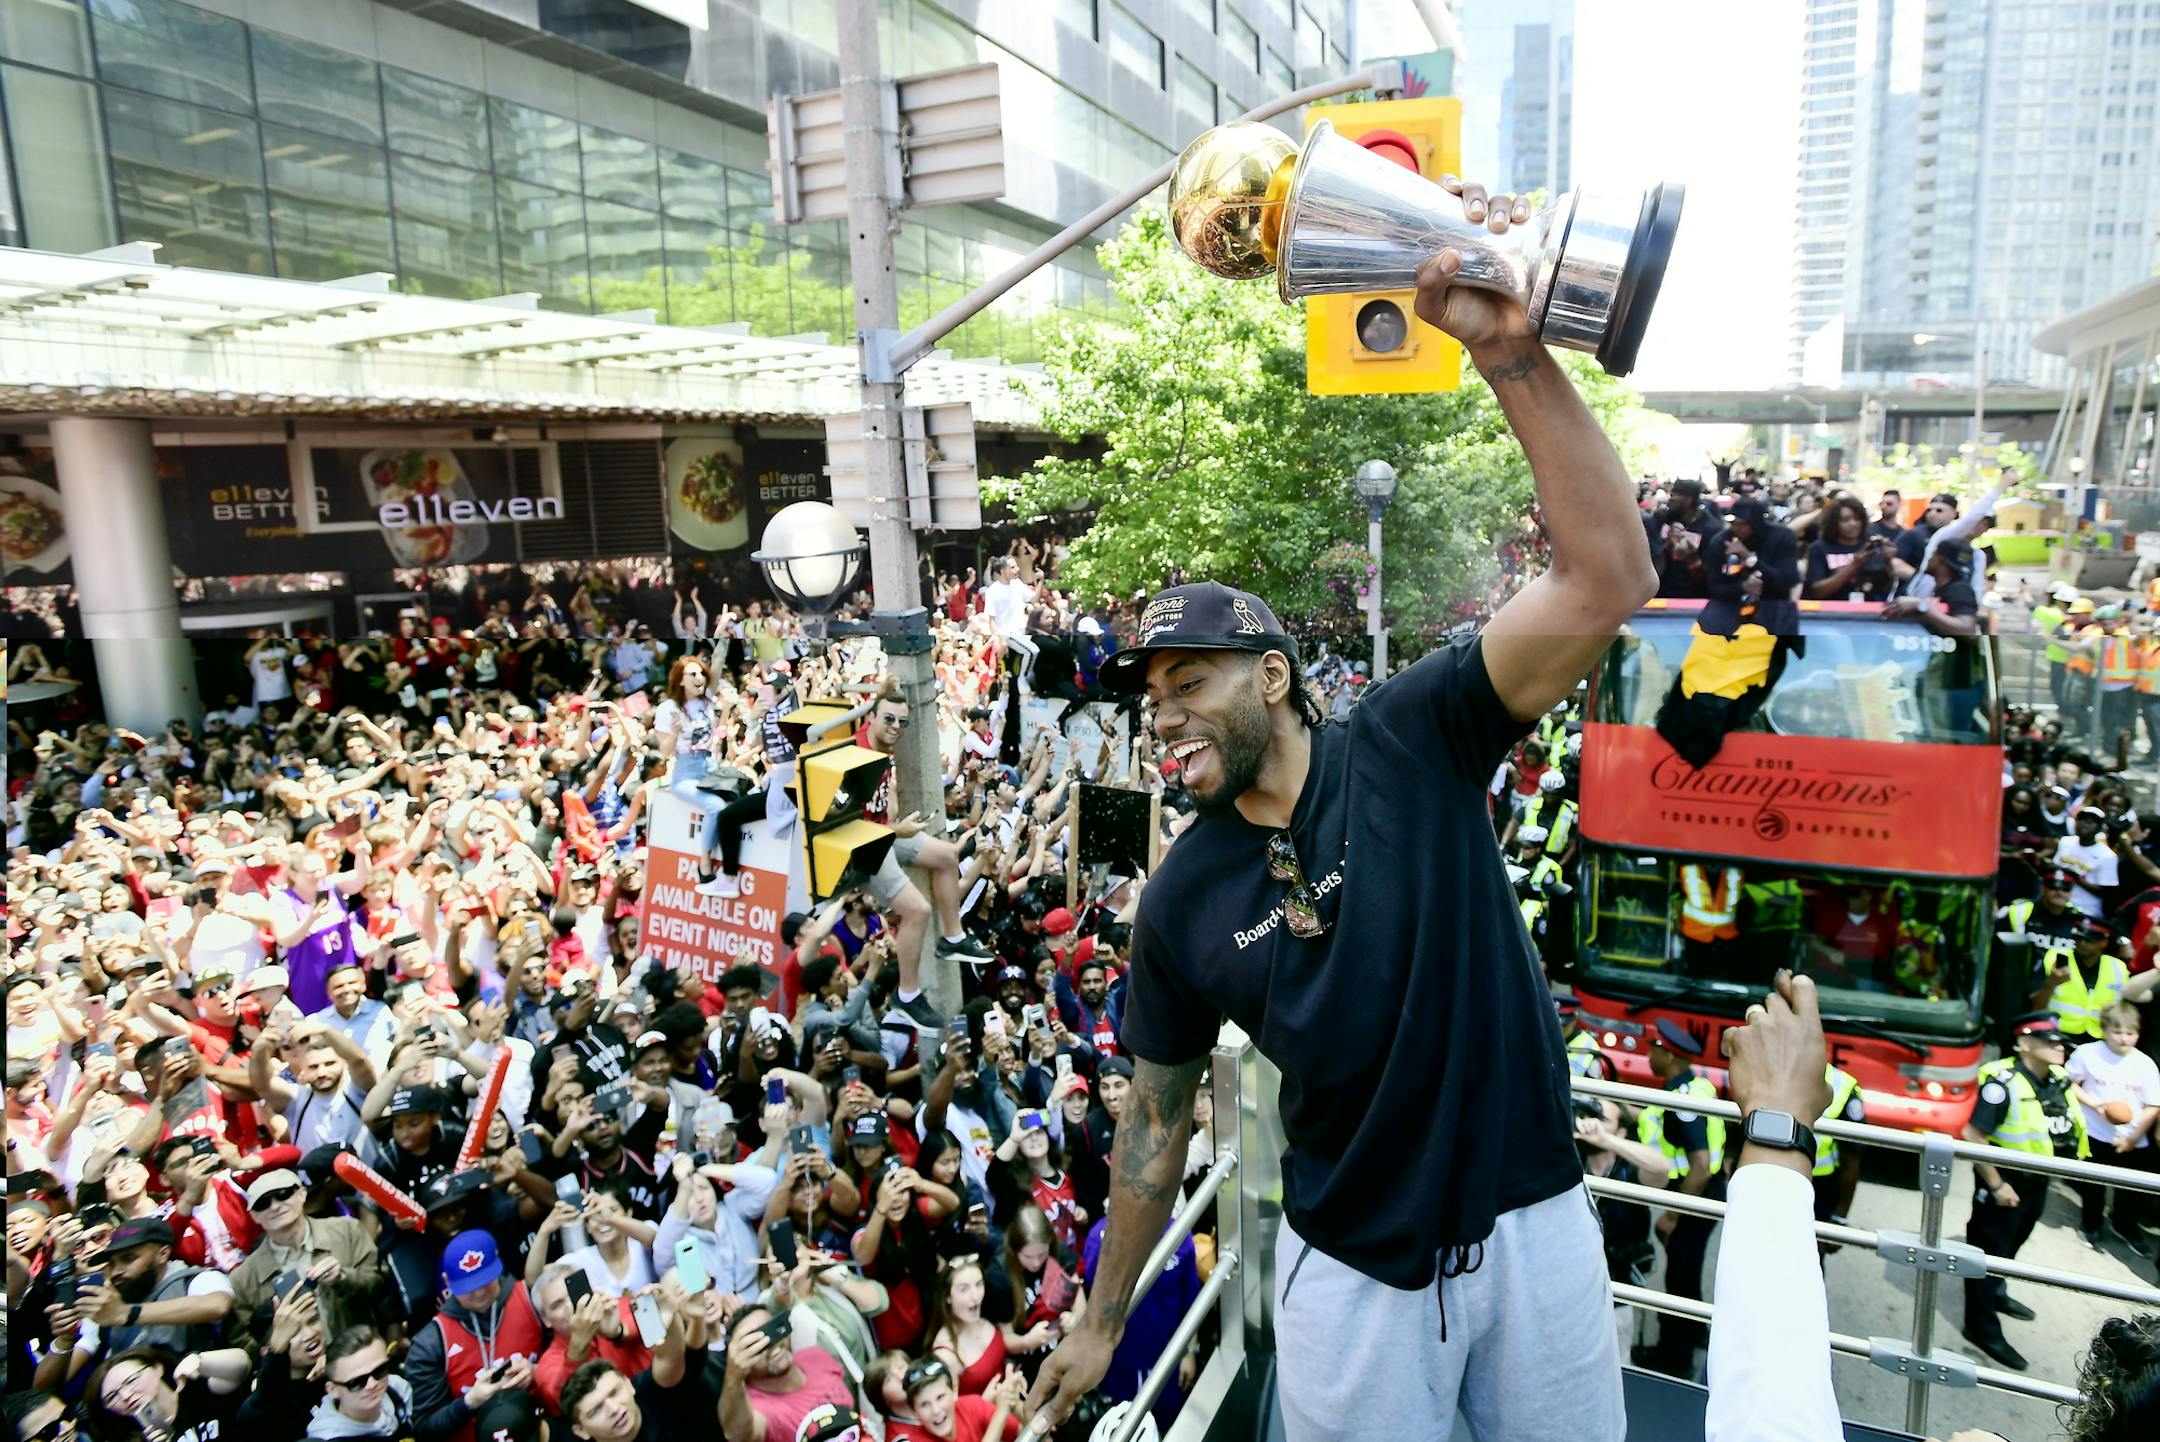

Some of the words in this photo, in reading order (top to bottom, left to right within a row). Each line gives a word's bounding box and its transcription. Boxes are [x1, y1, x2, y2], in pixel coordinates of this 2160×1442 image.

[210, 485, 329, 502] e11evn
[760, 485, 817, 499] BETTER
[212, 502, 331, 520] BETTR
[1893, 634, 1957, 654] 85139
[1650, 753, 1912, 814] Champions
[1660, 811, 1747, 828] TORONTO
[1796, 823, 1891, 840] RAPTORS
[651, 882, 747, 926] AVAILABLE
[749, 905, 778, 934] ON
[647, 911, 705, 948] EVENT
[665, 949, 726, 984] MAPLE
